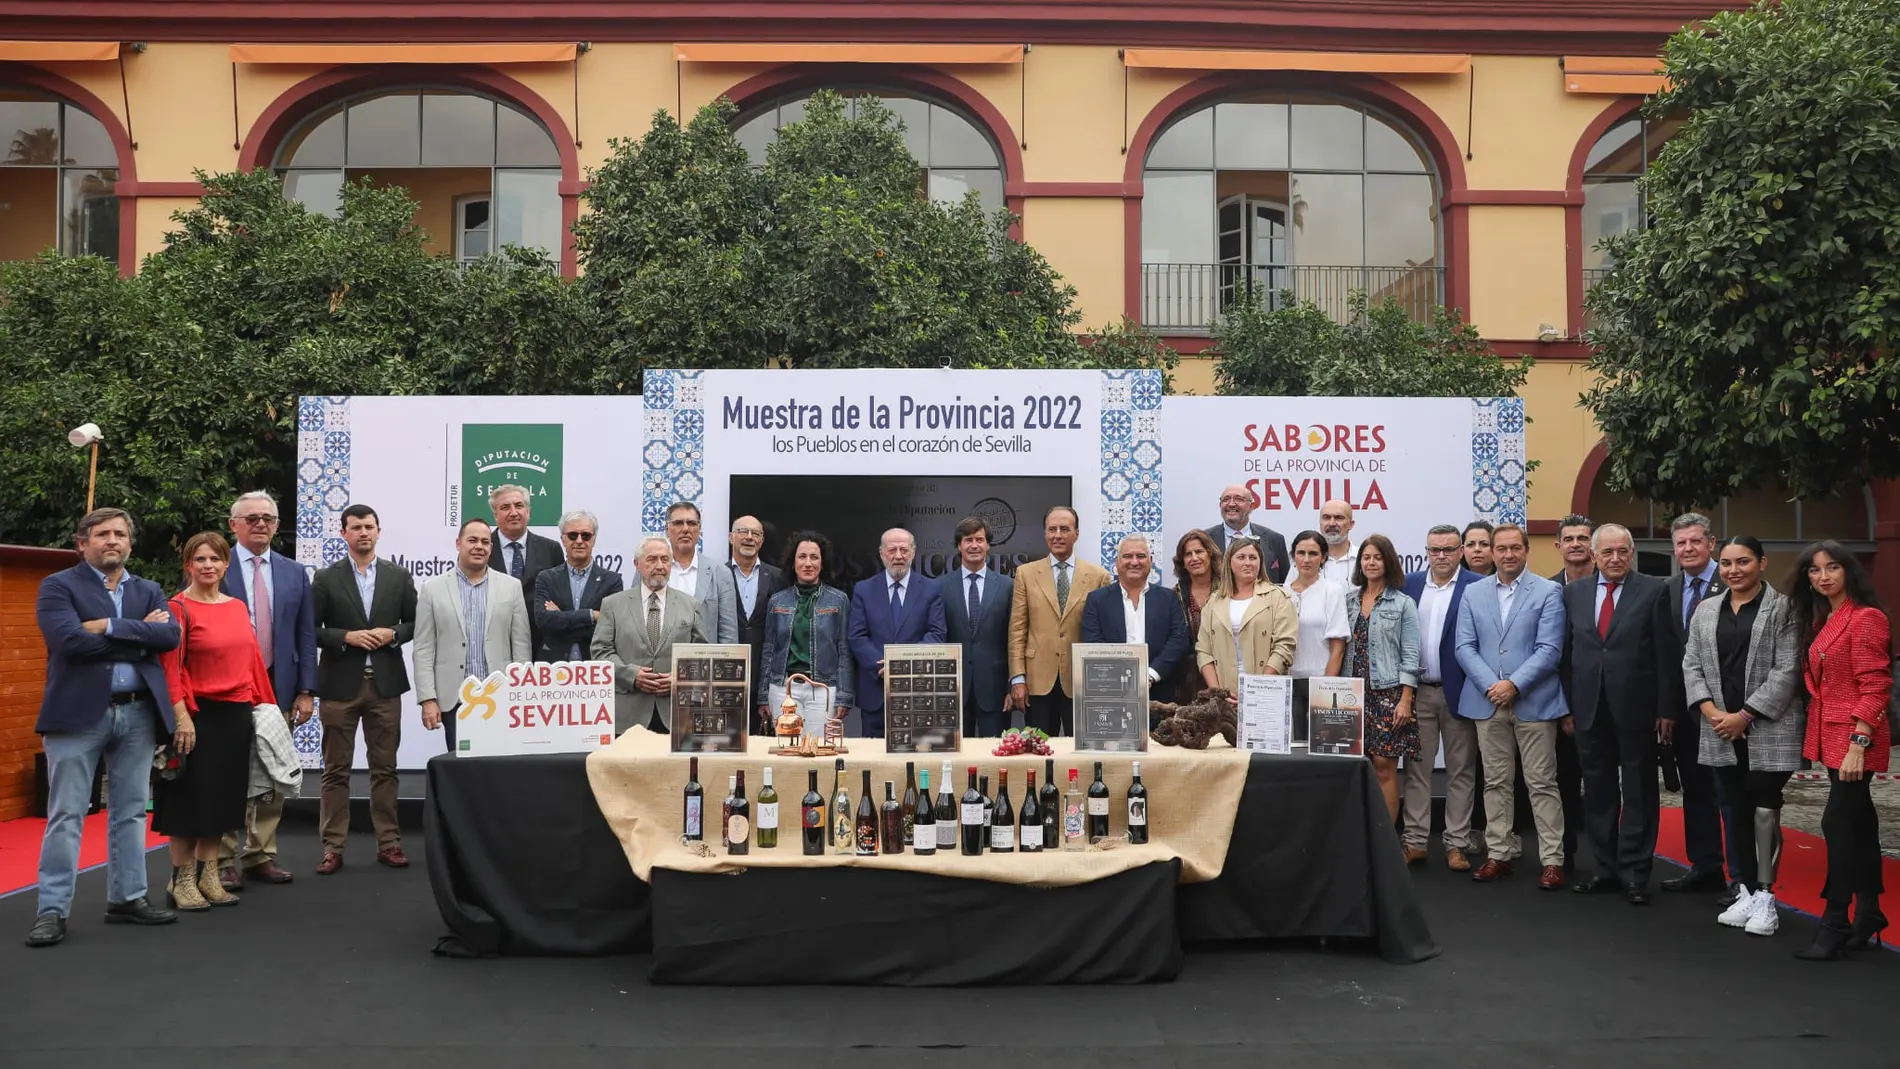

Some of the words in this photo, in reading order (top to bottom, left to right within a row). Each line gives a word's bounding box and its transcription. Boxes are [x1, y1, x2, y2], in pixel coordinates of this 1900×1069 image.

[723, 395, 822, 430] Muestra
[831, 395, 860, 430] de
[869, 395, 890, 430] la
[899, 395, 1014, 430] Provincia
[1024, 395, 1082, 430] 2022
[773, 435, 794, 453] los
[797, 435, 857, 453] Pueblos
[860, 439, 879, 453] en
[882, 435, 895, 453] el
[898, 434, 959, 453] corazón
[961, 434, 982, 453] de
[985, 434, 1031, 453] Sevilla
[1244, 424, 1386, 453] SABORES
[474, 450, 550, 468] DIPUTACION
[1244, 459, 1261, 473] DE
[1266, 459, 1284, 473] LA
[1287, 459, 1366, 473] PROVINCIA
[1369, 459, 1386, 473] DE
[506, 471, 518, 480] DE
[476, 484, 548, 497] SELA
[450, 484, 458, 527] PRODETUR
[509, 665, 612, 687] SABORES
[509, 691, 522, 702] DE
[525, 690, 538, 701] LA
[541, 689, 597, 701] PROVINCIA
[599, 688, 612, 699] DE
[508, 703, 613, 729] SEVILLA
[763, 807, 775, 818] M
